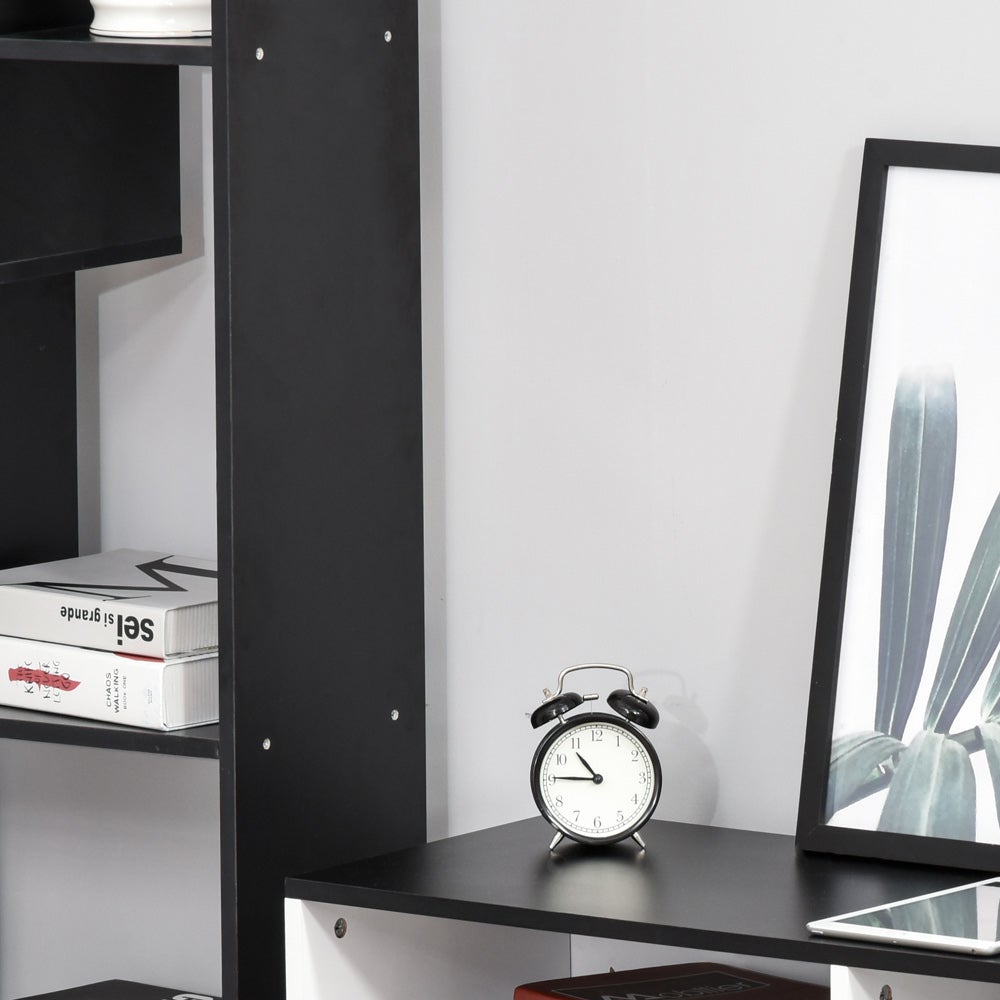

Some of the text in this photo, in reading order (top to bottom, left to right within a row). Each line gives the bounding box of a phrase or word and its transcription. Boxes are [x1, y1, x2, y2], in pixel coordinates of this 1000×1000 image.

[60, 605, 155, 646] sei si grande
[591, 730, 603, 742] 12
[615, 735, 620, 747] 1
[571, 737, 581, 749] 11
[556, 754, 567, 766] 10
[631, 750, 639, 762] 2
[548, 774, 556, 786] 9
[639, 772, 647, 784] 3
[555, 796, 563, 807] 8
[630, 793, 638, 805] 4
[573, 810, 581, 822] 7
[593, 816, 602, 828] 6
[616, 810, 624, 822] 5
